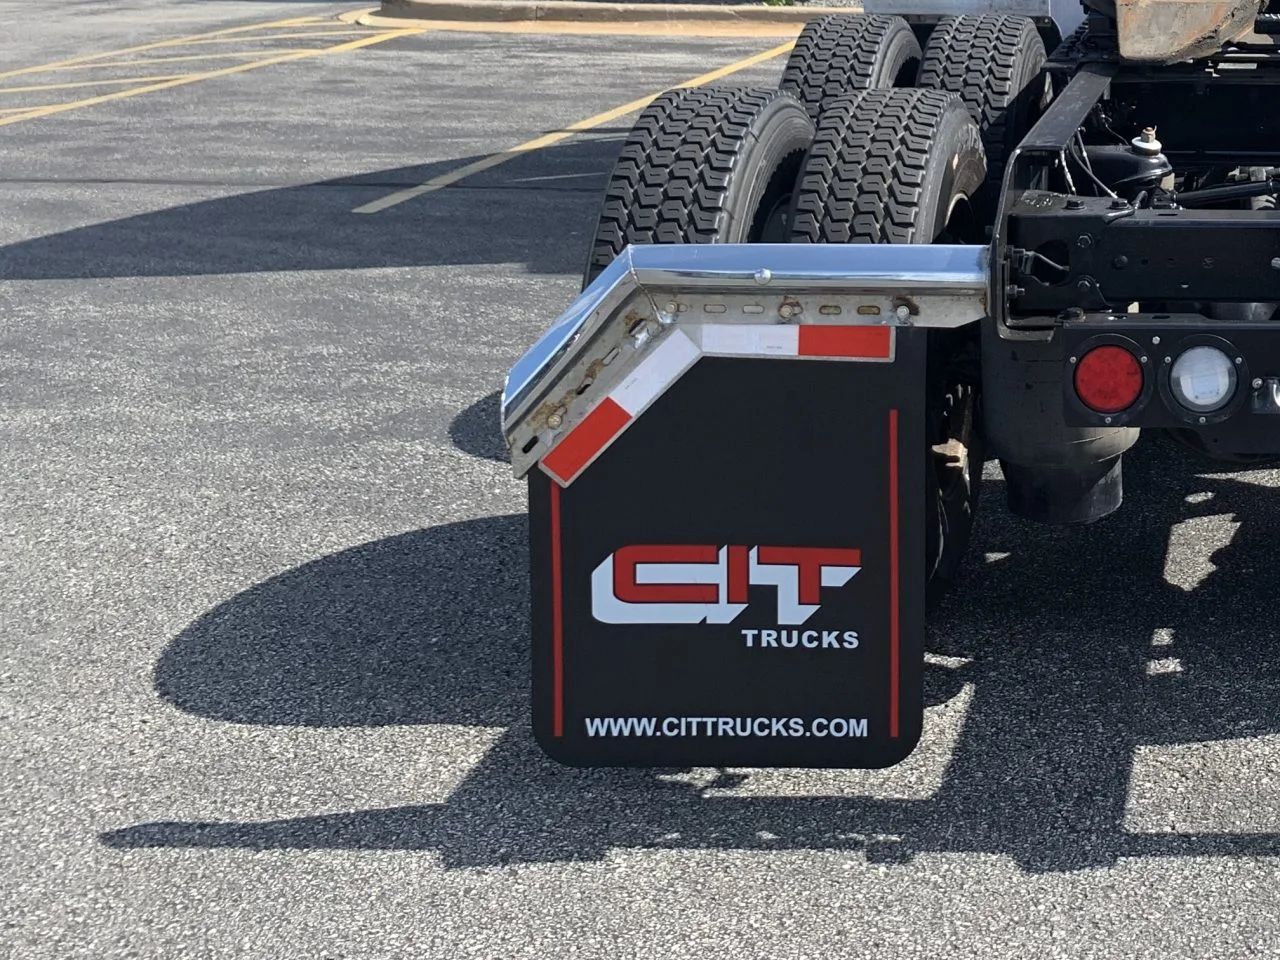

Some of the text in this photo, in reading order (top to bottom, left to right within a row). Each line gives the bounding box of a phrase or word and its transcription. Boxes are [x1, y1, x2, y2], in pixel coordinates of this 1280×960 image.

[591, 544, 862, 625] CIT
[741, 629, 859, 649] TRUCKS
[585, 716, 868, 738] WWW.CITTRUCKS.COM
